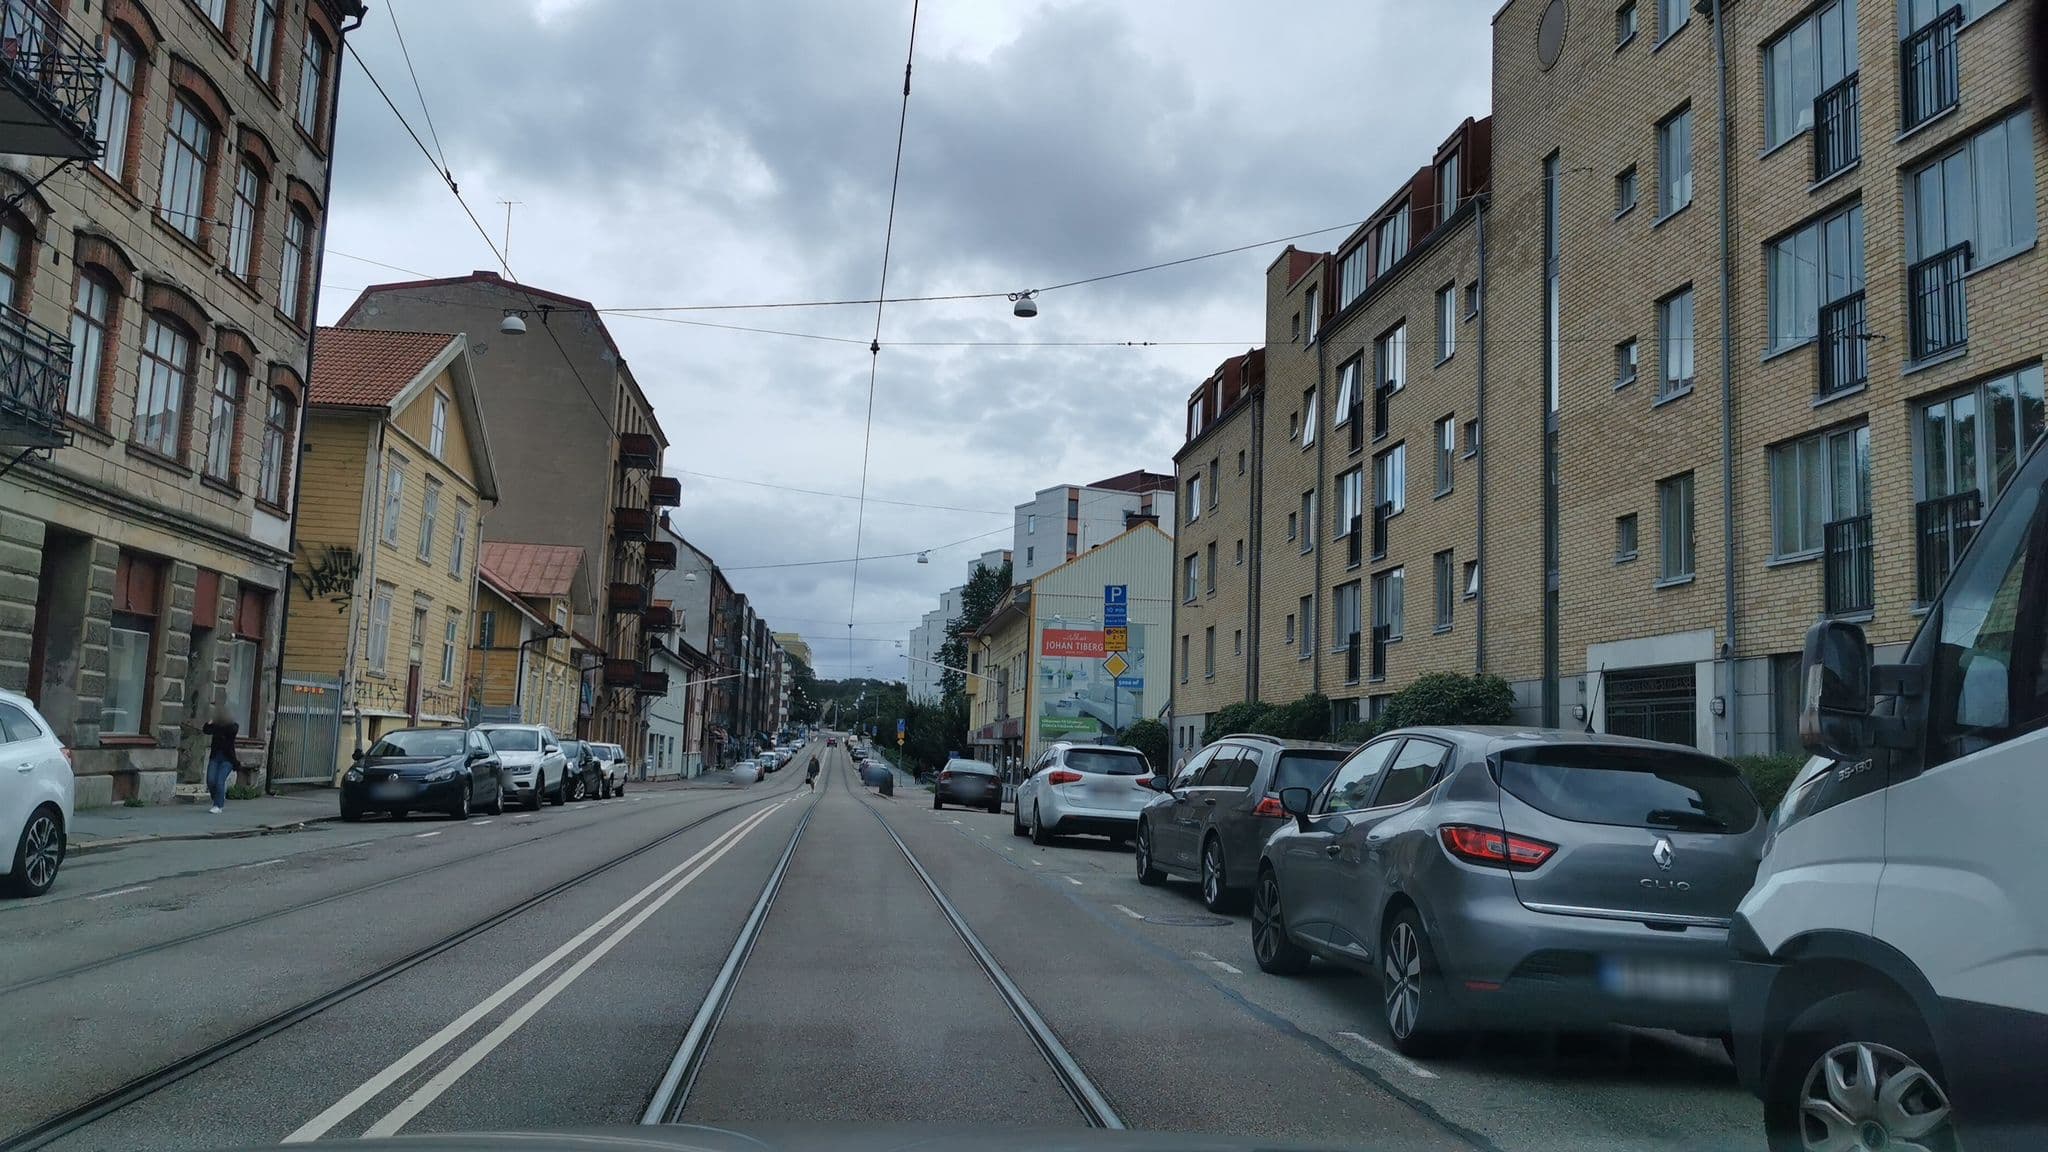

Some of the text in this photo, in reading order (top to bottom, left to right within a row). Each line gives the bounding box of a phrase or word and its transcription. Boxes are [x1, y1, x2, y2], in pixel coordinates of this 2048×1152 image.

[1111, 586, 1122, 602] P
[1046, 641, 1073, 650] JOHAN
[1075, 642, 1104, 652] TIBERG
[1639, 878, 1691, 891] CLIO
